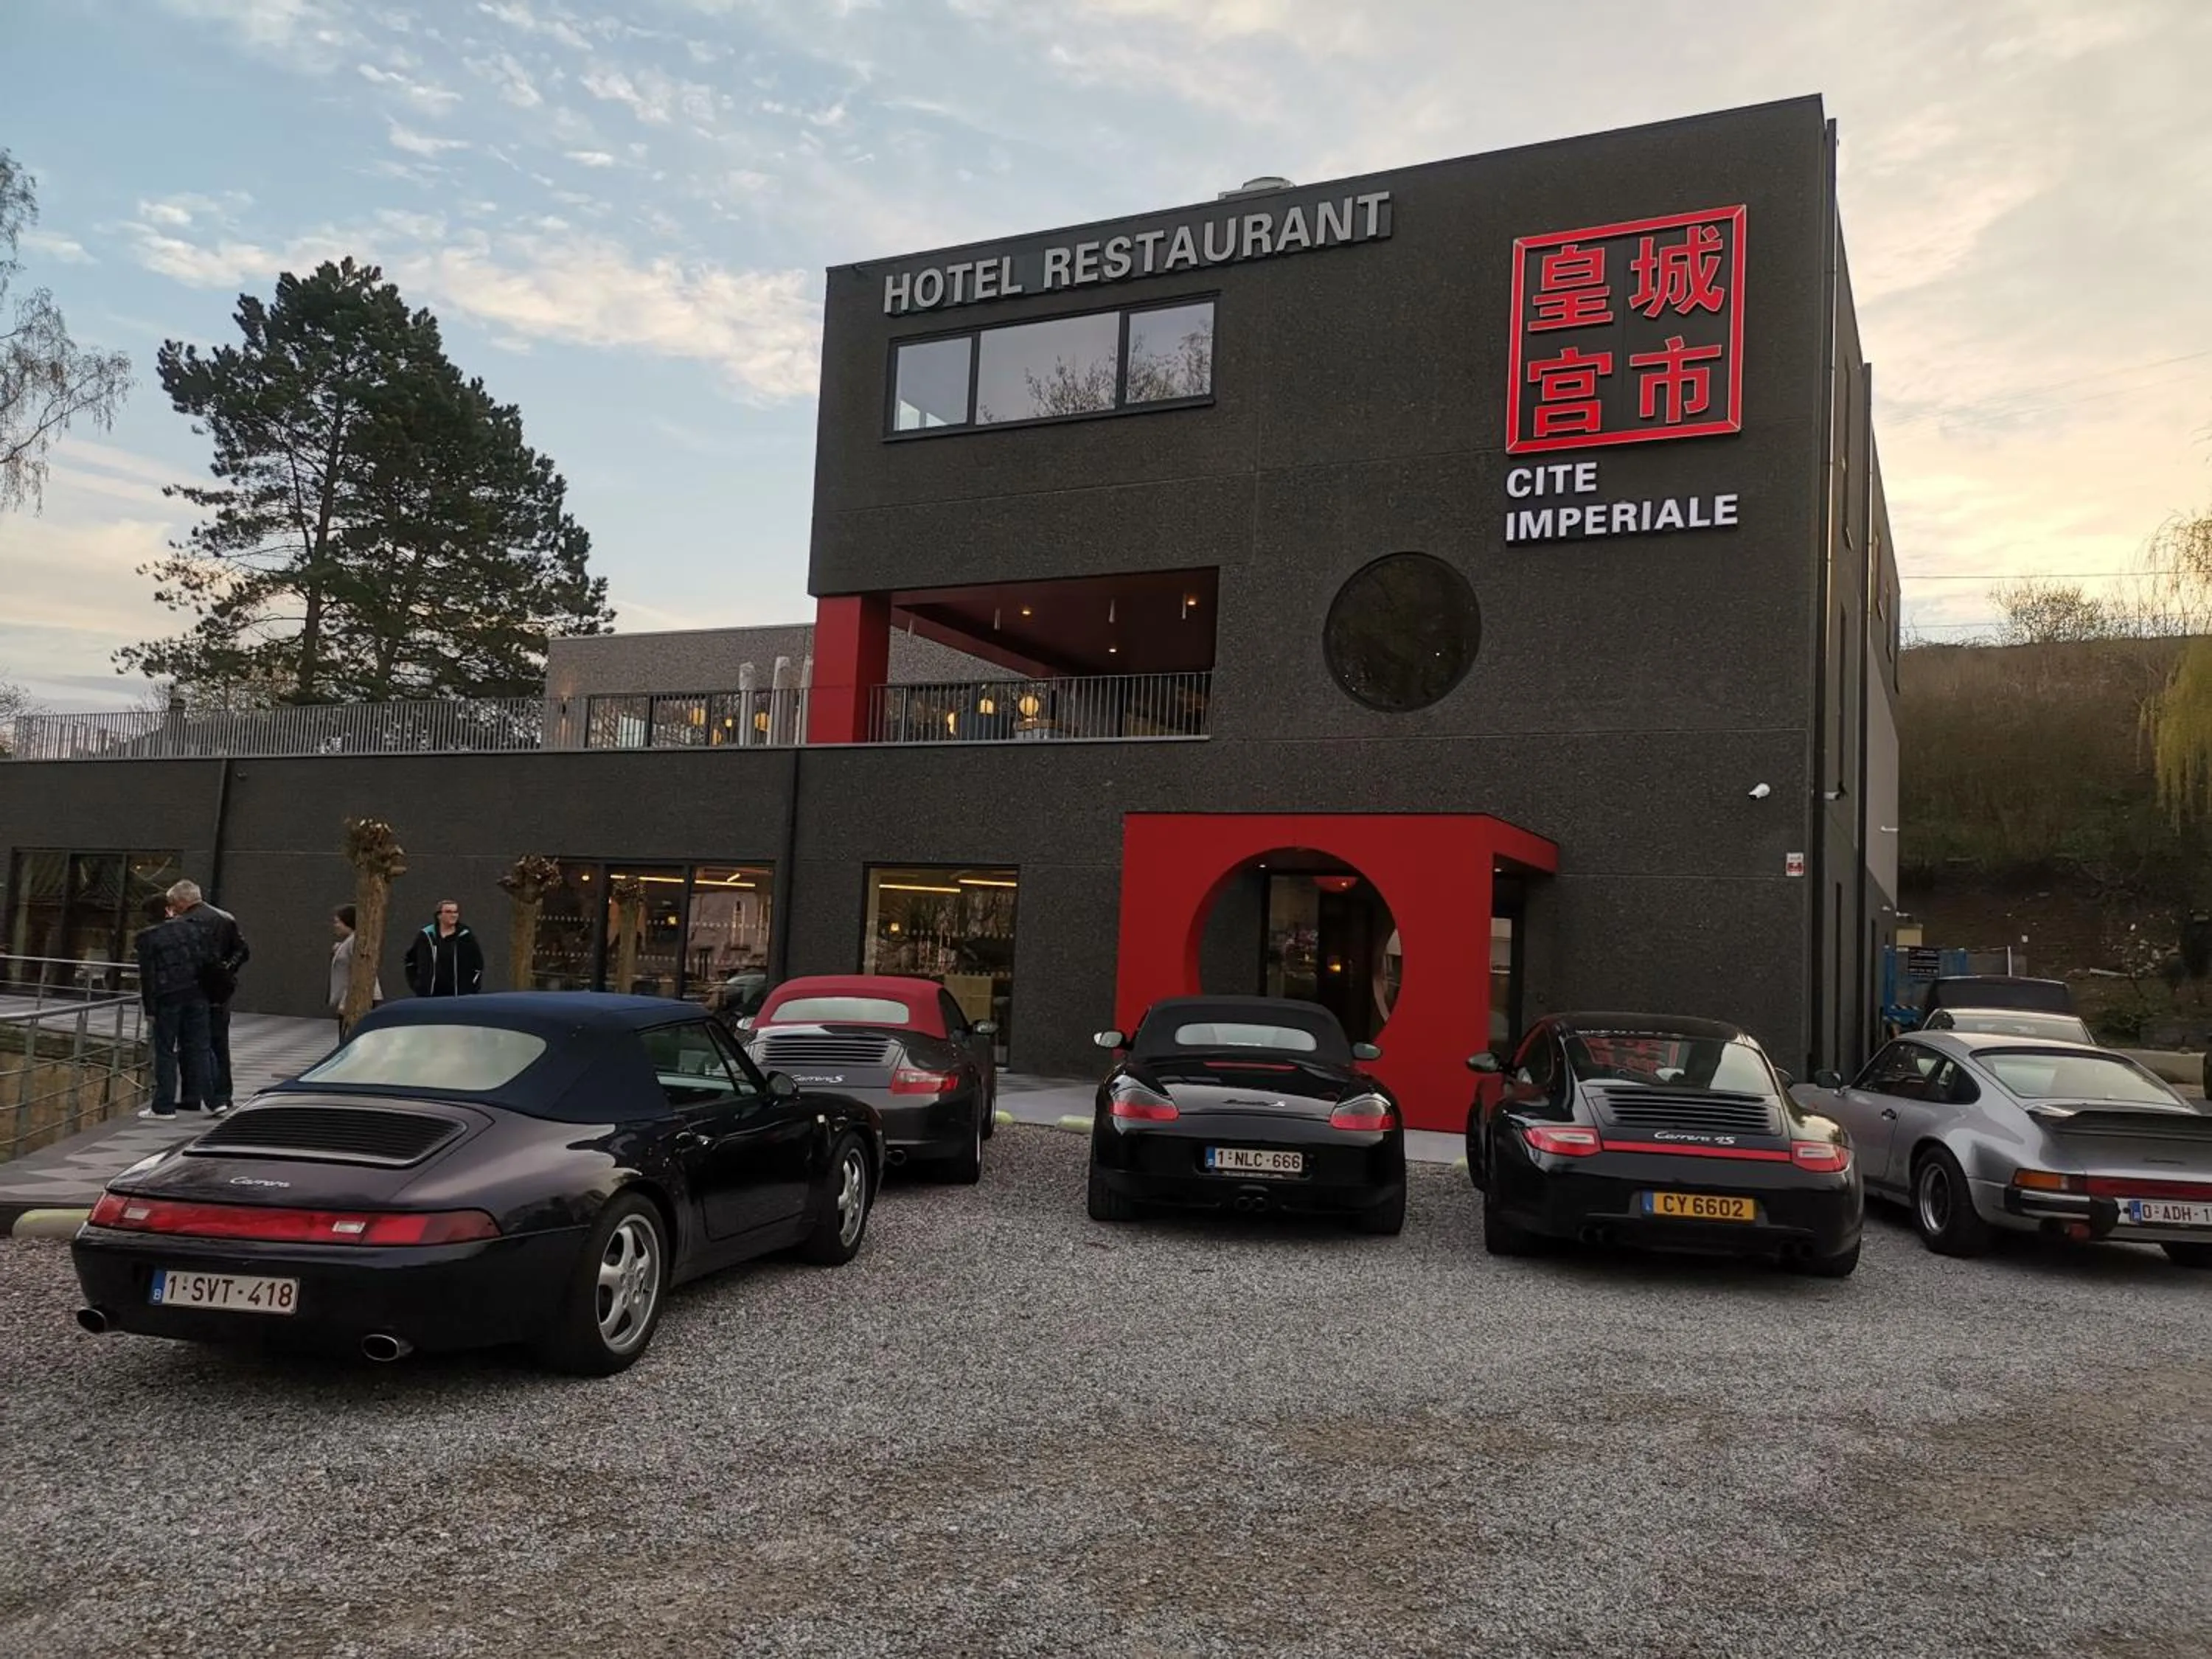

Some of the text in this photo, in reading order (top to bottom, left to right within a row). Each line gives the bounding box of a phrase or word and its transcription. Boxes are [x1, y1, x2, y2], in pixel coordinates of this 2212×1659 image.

[884, 191, 1390, 313] HOTEL RESTAURANT
[1506, 462, 1597, 498] CITE
[1506, 493, 1739, 542] IMPERIALE
[1654, 1130, 1711, 1141] Carrera
[1692, 1197, 1745, 1217] 6602
